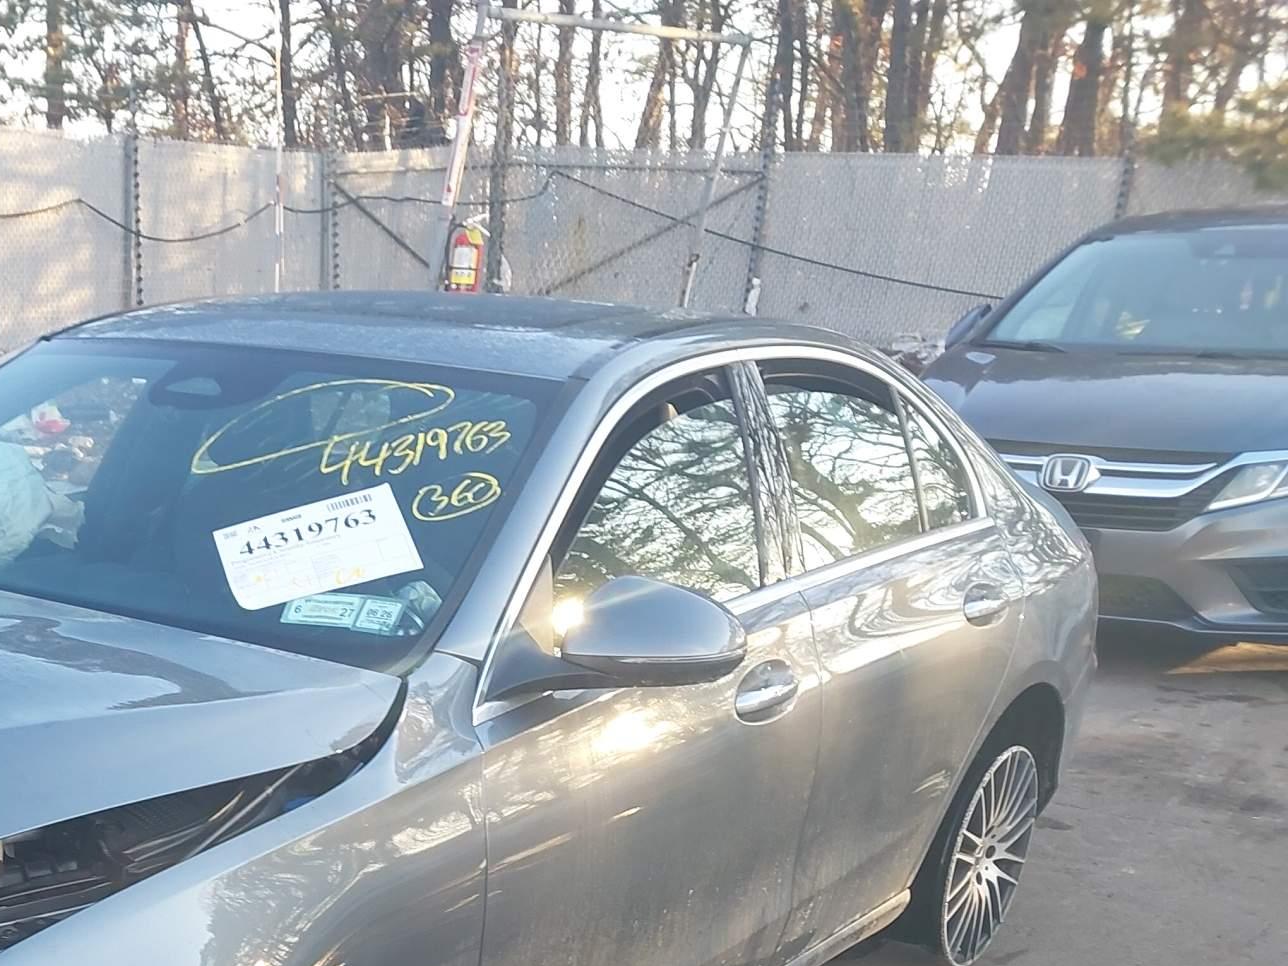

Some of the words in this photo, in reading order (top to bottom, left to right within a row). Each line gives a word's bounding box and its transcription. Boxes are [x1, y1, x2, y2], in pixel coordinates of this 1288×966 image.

[320, 421, 511, 485] 44319763
[239, 509, 377, 555] 44319763
[294, 604, 302, 614] 6
[341, 607, 355, 618] 27
